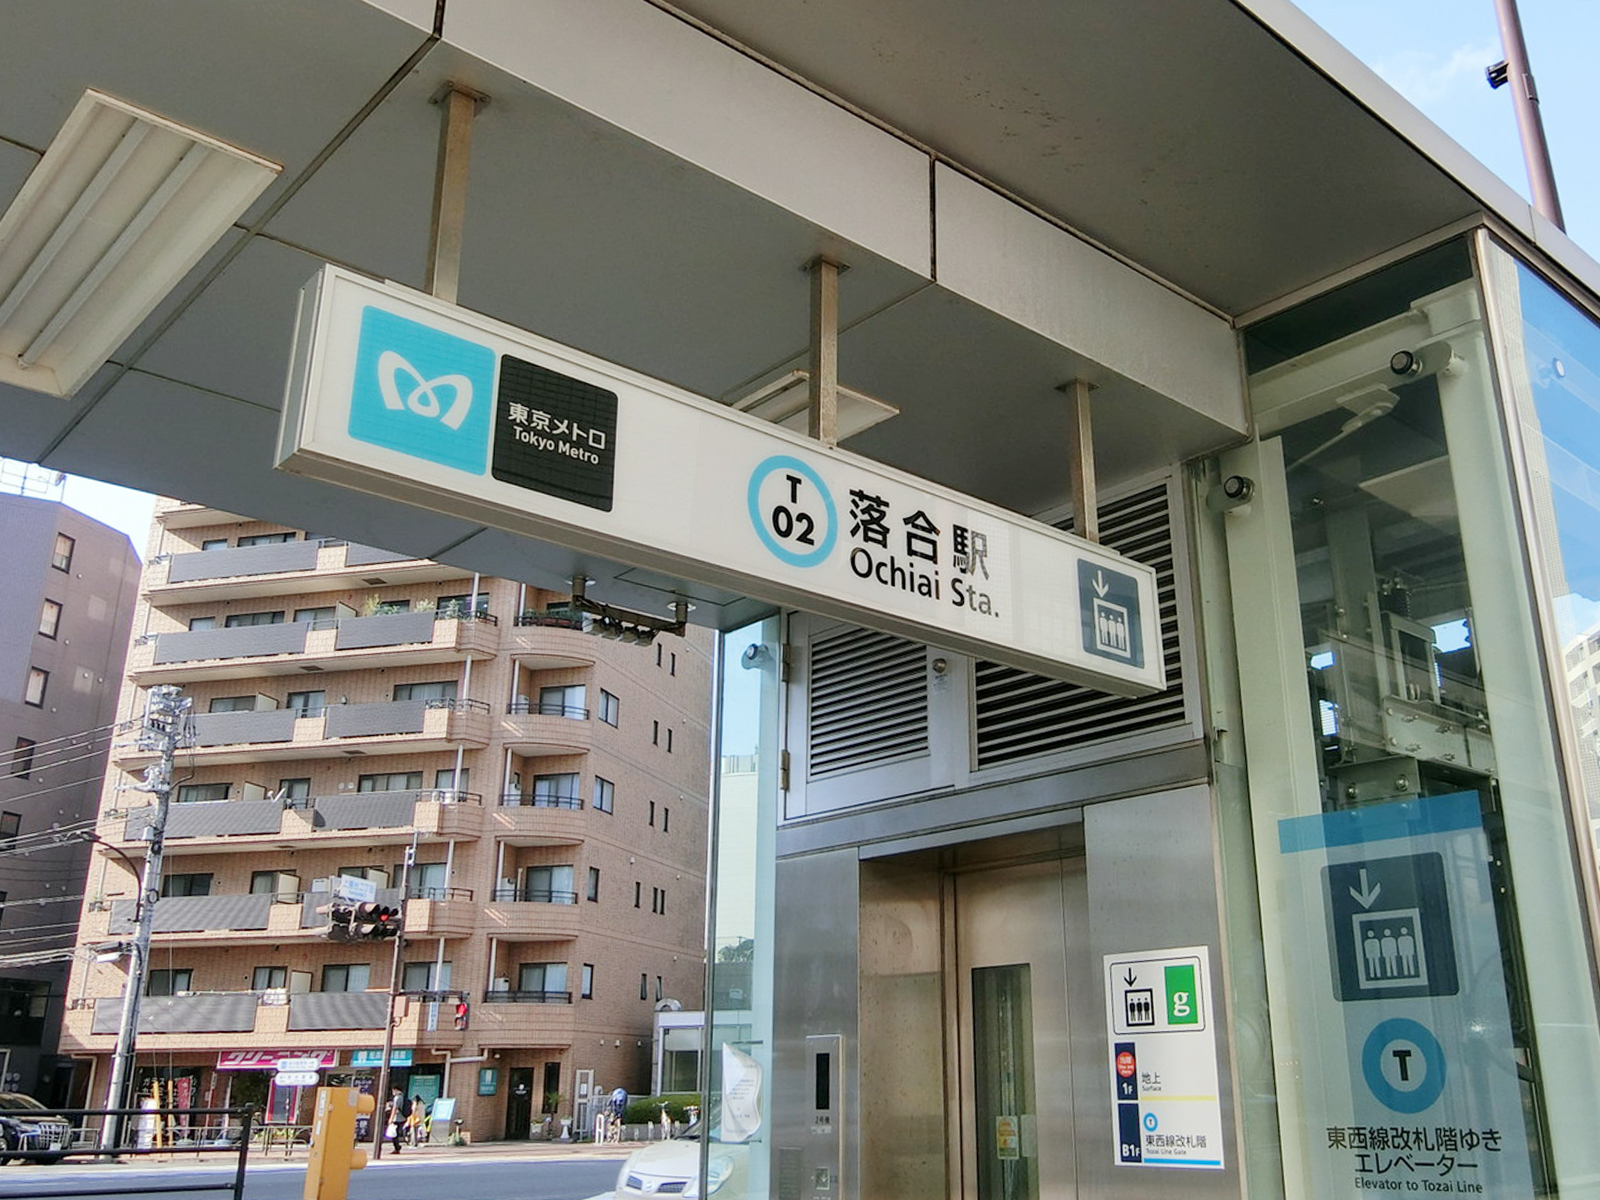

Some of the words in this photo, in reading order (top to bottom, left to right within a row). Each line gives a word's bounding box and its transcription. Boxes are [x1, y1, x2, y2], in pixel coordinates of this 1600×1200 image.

[508, 402, 606, 450] 東京メトロ
[513, 425, 555, 450] Tokyo
[558, 441, 599, 465] Metro
[786, 474, 802, 504] T
[772, 505, 815, 546] 02
[849, 489, 990, 580] 落合駅
[850, 546, 940, 600] Ochiai
[951, 578, 999, 617] Sta.
[1173, 991, 1190, 1017] g
[1141, 1071, 1161, 1084] 地上
[1392, 1050, 1412, 1082] T
[1122, 1082, 1133, 1095] 1F
[1122, 1143, 1141, 1157] B1F
[1145, 1134, 1207, 1148] 東西線改札階
[1326, 1126, 1502, 1152] 東西線改札階ゆき
[1355, 1153, 1478, 1177] エレベーター
[1355, 1177, 1402, 1191] Elevator
[1406, 1180, 1419, 1191] to
[1421, 1179, 1453, 1193] Tozai
[1457, 1180, 1483, 1194] Line
